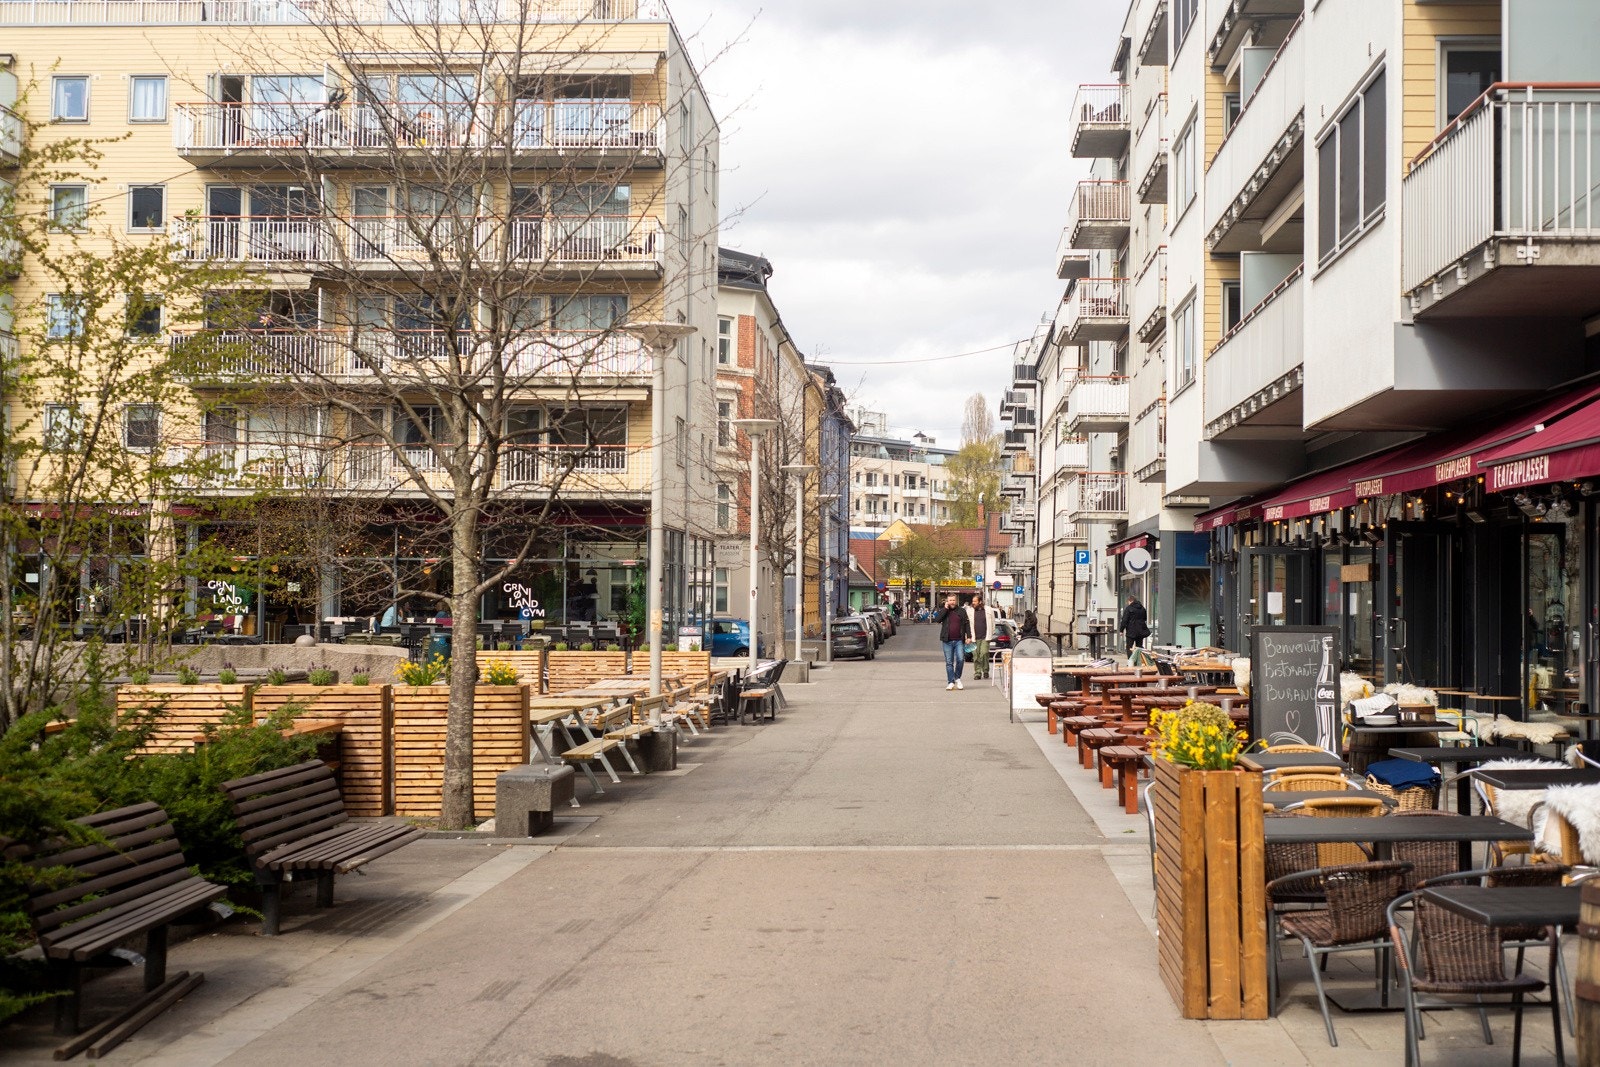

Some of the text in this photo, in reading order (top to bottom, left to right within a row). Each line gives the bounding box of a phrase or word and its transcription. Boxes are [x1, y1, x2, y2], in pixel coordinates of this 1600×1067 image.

[1435, 455, 1471, 482] TEATERPLASSEN
[1494, 455, 1549, 488] TEATERPLASSEN
[1079, 552, 1086, 562] P
[522, 608, 545, 617] GYM
[1263, 635, 1320, 657] Benvenuti
